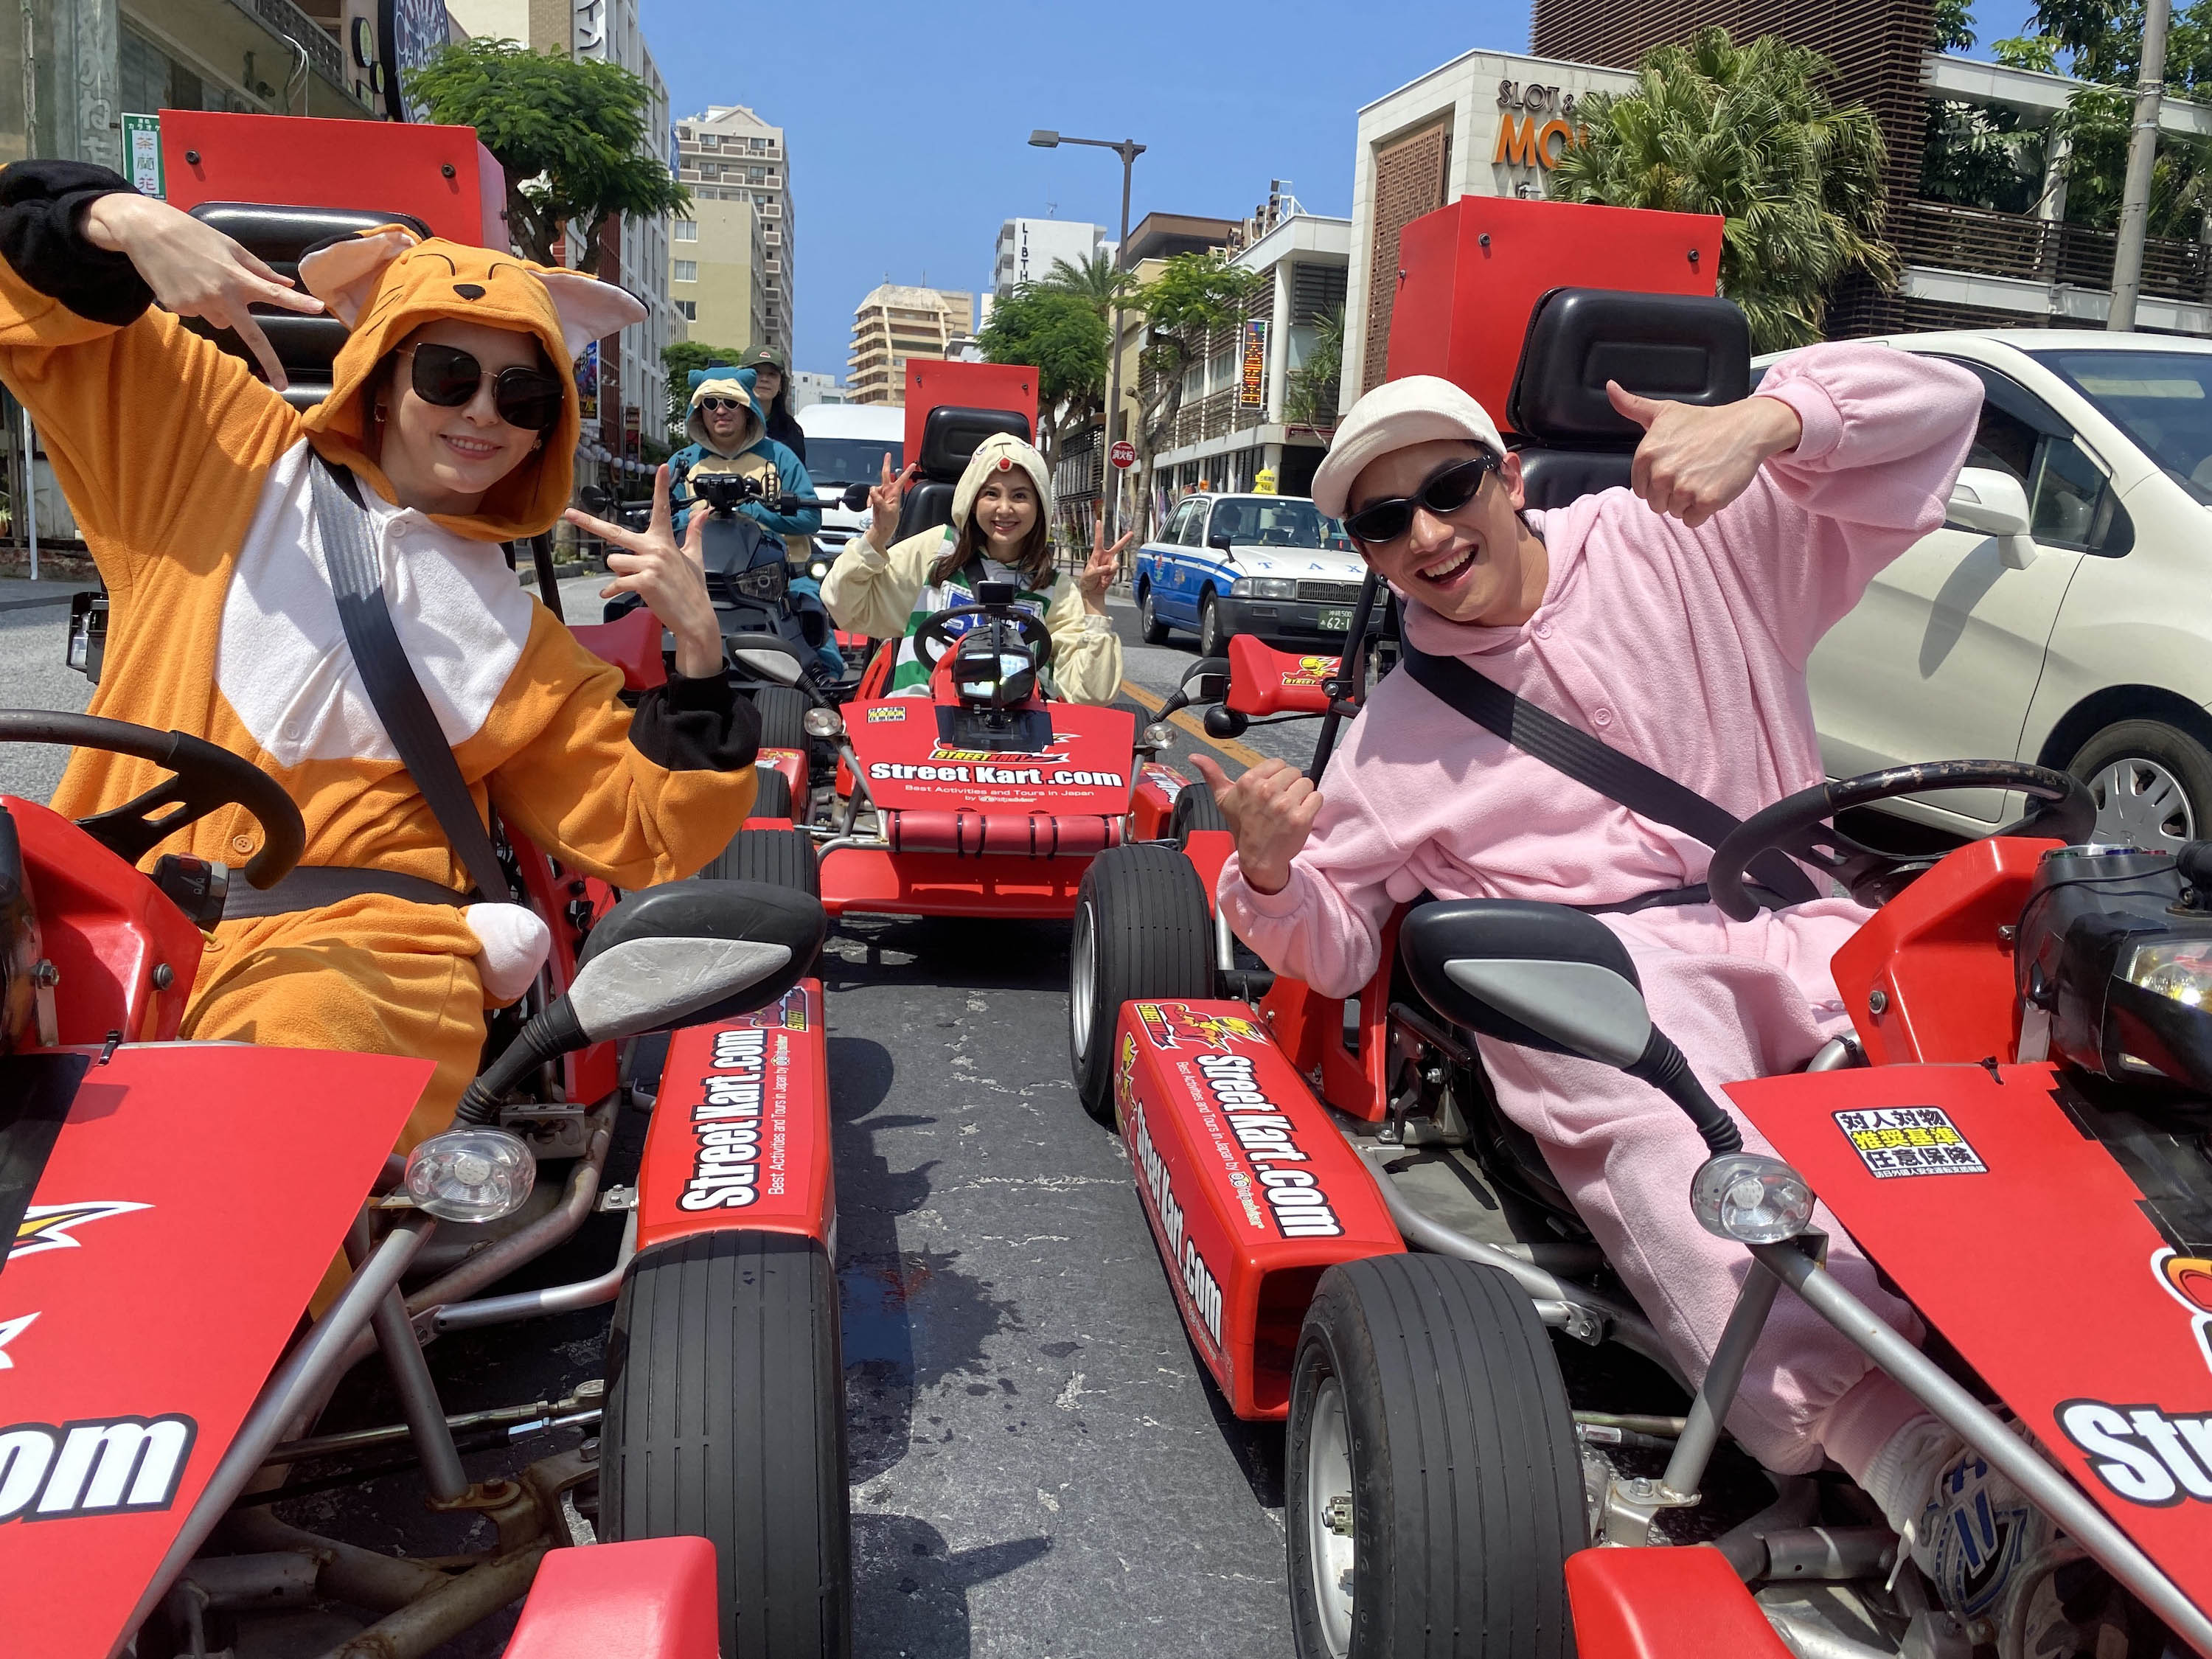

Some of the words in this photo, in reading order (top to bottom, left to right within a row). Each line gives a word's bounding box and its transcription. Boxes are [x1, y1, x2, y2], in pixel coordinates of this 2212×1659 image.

[1496, 80, 1560, 112] SLOT
[1562, 94, 1574, 115] &
[128, 122, 161, 131] カラオケ
[1491, 113, 1587, 171] MO
[1020, 222, 1029, 281] LIBTH
[1258, 561, 1364, 574] TAX
[1326, 617, 1350, 630] 62-1
[934, 751, 992, 762] STREET
[870, 762, 970, 782] Street
[975, 766, 1043, 785] Kart
[1047, 770, 1124, 787] .com
[935, 786, 987, 795] Activities
[713, 1029, 764, 1071] .com
[773, 1066, 790, 1074] by
[1175, 1061, 1192, 1076] Best
[775, 1074, 789, 1093] Japan
[1183, 1074, 1204, 1102] Activities
[1196, 1055, 1277, 1112] Street
[695, 1073, 761, 1121] Kart
[1196, 1102, 1214, 1114] and
[771, 1099, 786, 1119] Tours
[1839, 1109, 1947, 1130] 対人対物
[772, 1118, 785, 1133] and
[1202, 1113, 1220, 1133] Tours
[1226, 1114, 1308, 1162] Kart
[1850, 1127, 1964, 1151] 推奨基準
[768, 1133, 785, 1172] Activities
[1215, 1140, 1236, 1162] Japan
[1865, 1147, 1976, 1169] 任意保険
[680, 1119, 758, 1211] Street
[1225, 1161, 1240, 1171] by
[768, 1172, 785, 1196] Best
[1253, 1163, 1340, 1237] .com
[1136, 1101, 1163, 1212] Street
[1183, 1239, 1222, 1349] .com
